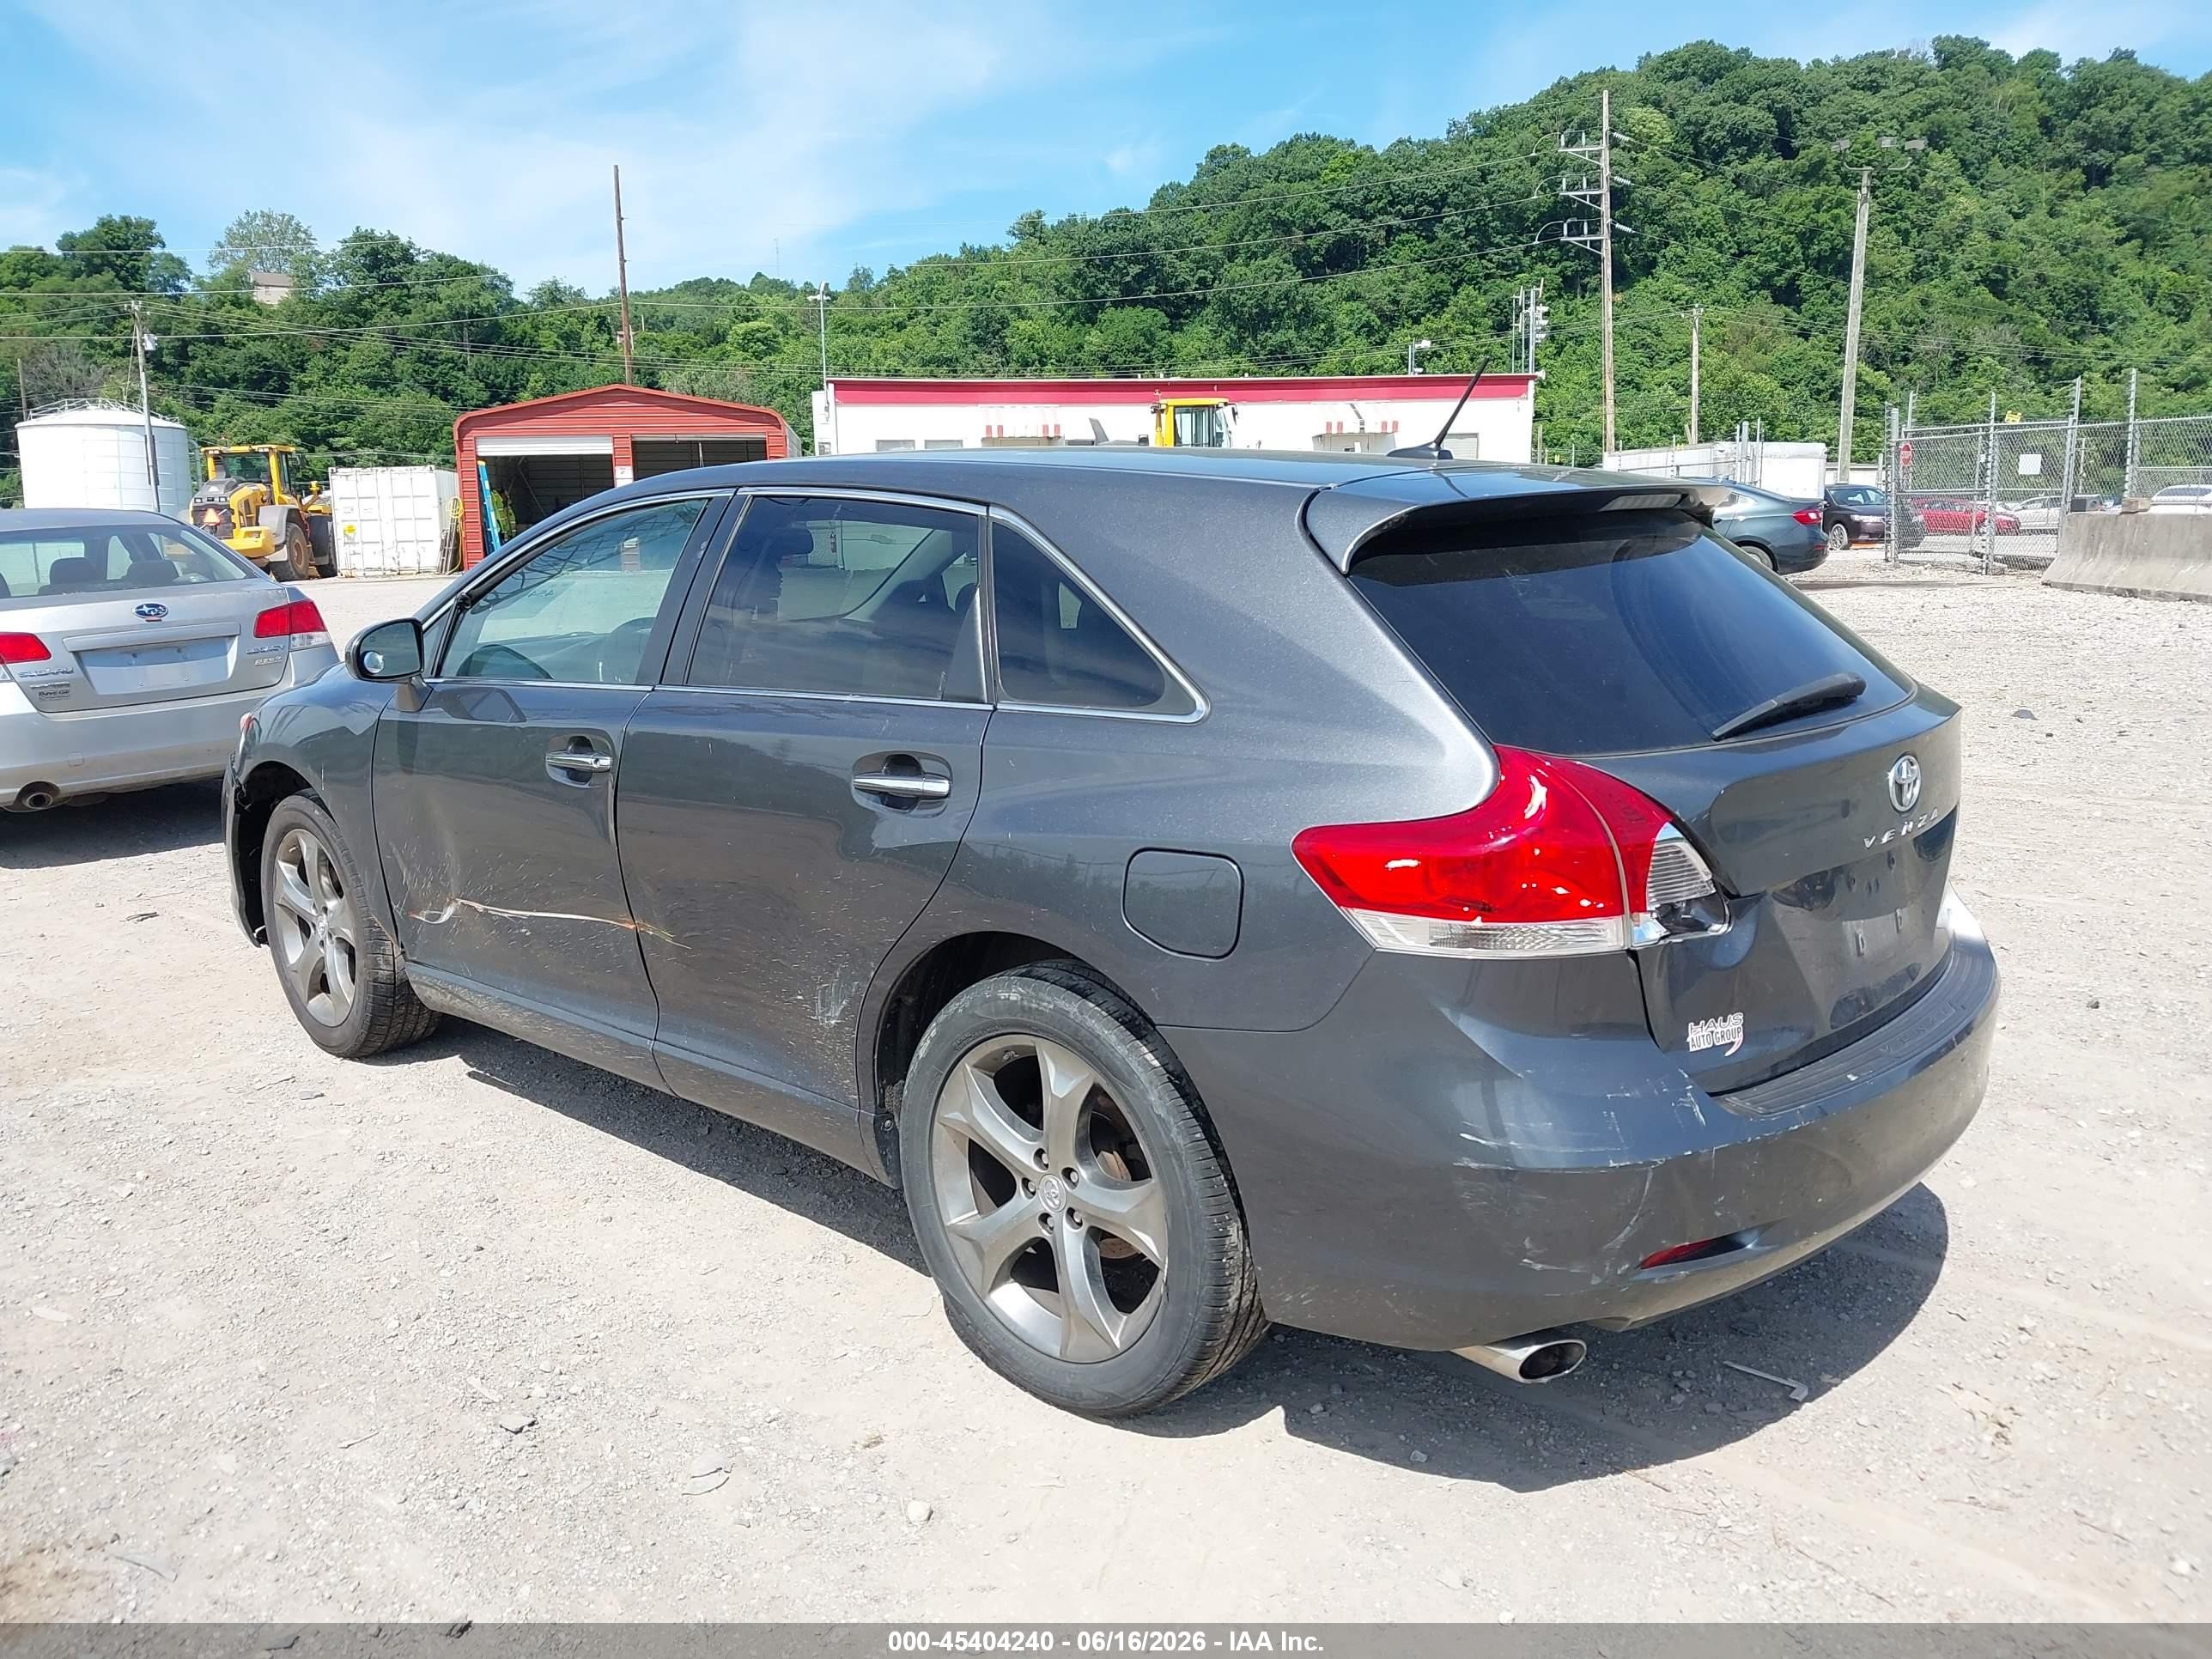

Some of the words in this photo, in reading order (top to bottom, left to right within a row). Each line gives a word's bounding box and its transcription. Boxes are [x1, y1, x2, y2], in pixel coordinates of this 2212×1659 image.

[1863, 808, 1938, 848] VENZA
[1688, 1012, 1743, 1036] HAUS
[1691, 1032, 1712, 1048] AUTO
[1714, 1026, 1742, 1044] GROUP
